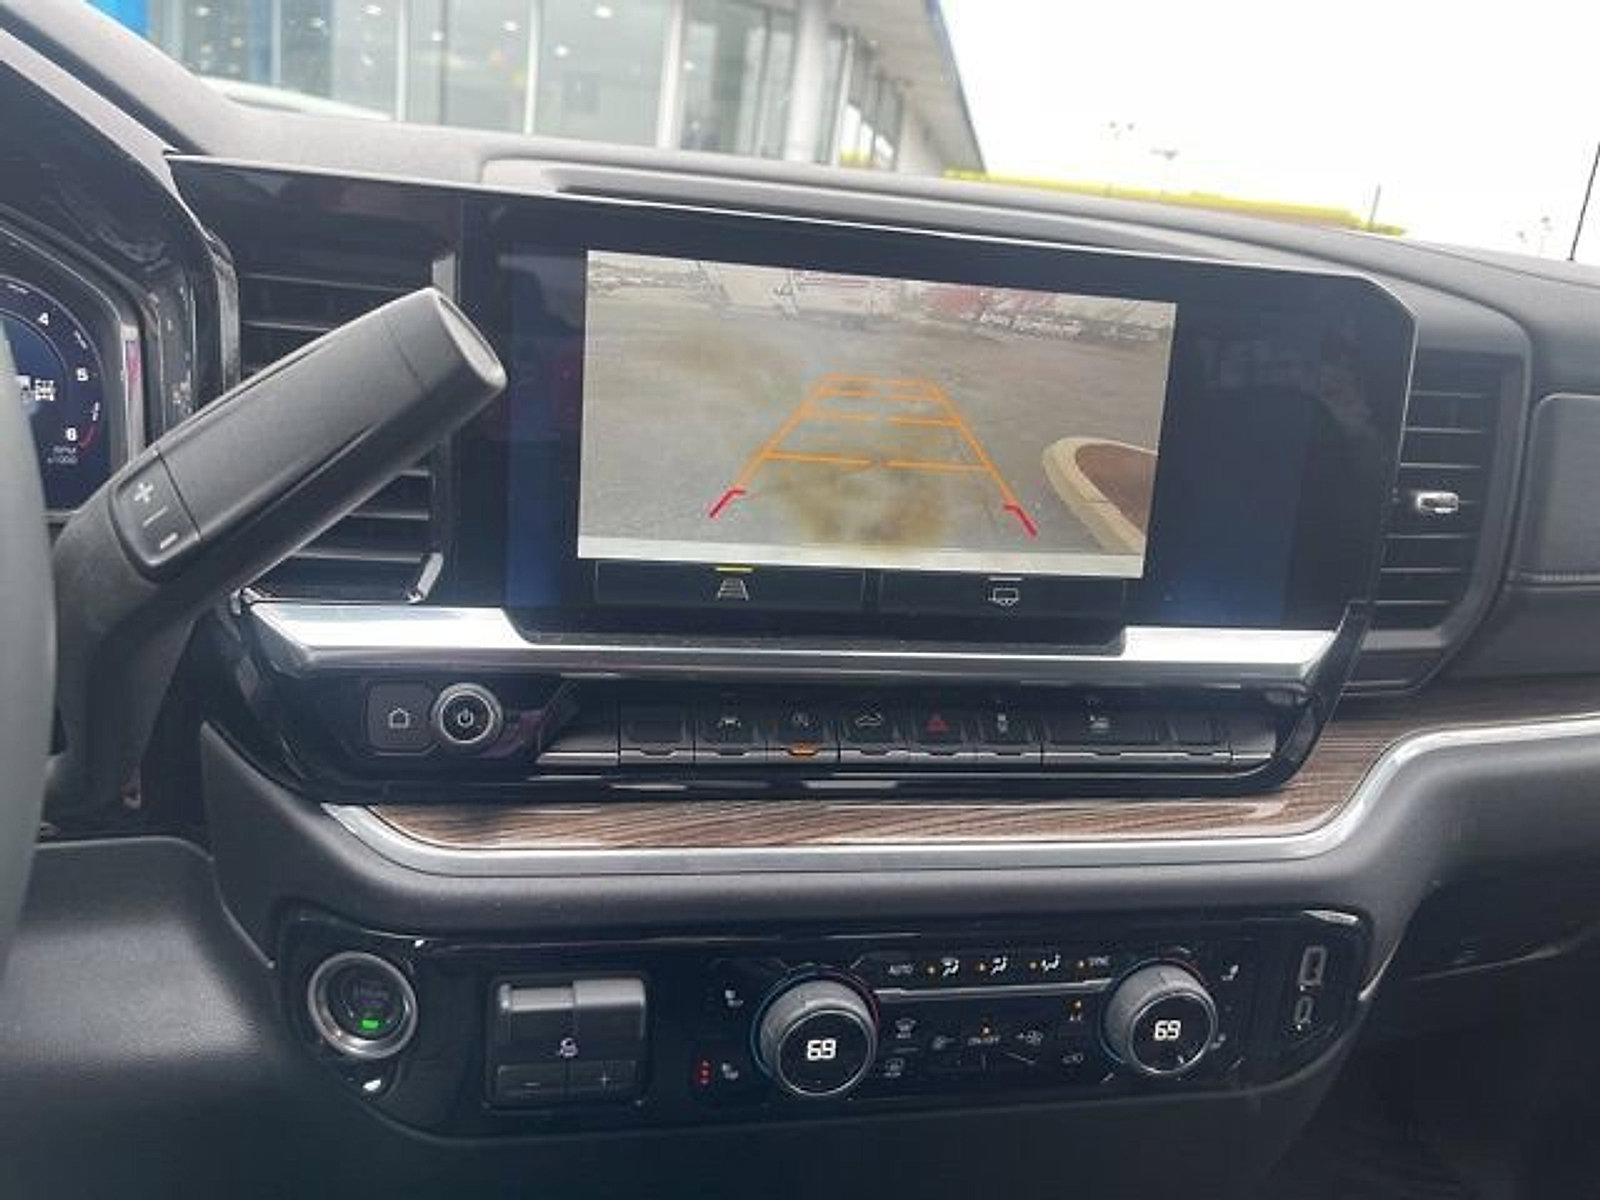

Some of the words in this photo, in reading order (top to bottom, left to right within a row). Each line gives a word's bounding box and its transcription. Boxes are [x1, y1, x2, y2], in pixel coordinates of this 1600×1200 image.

[38, 312, 49, 326] 4
[76, 367, 88, 381] 5
[65, 427, 77, 441] 6
[1154, 1020, 1181, 1041] 69
[807, 1038, 837, 1060] 69
